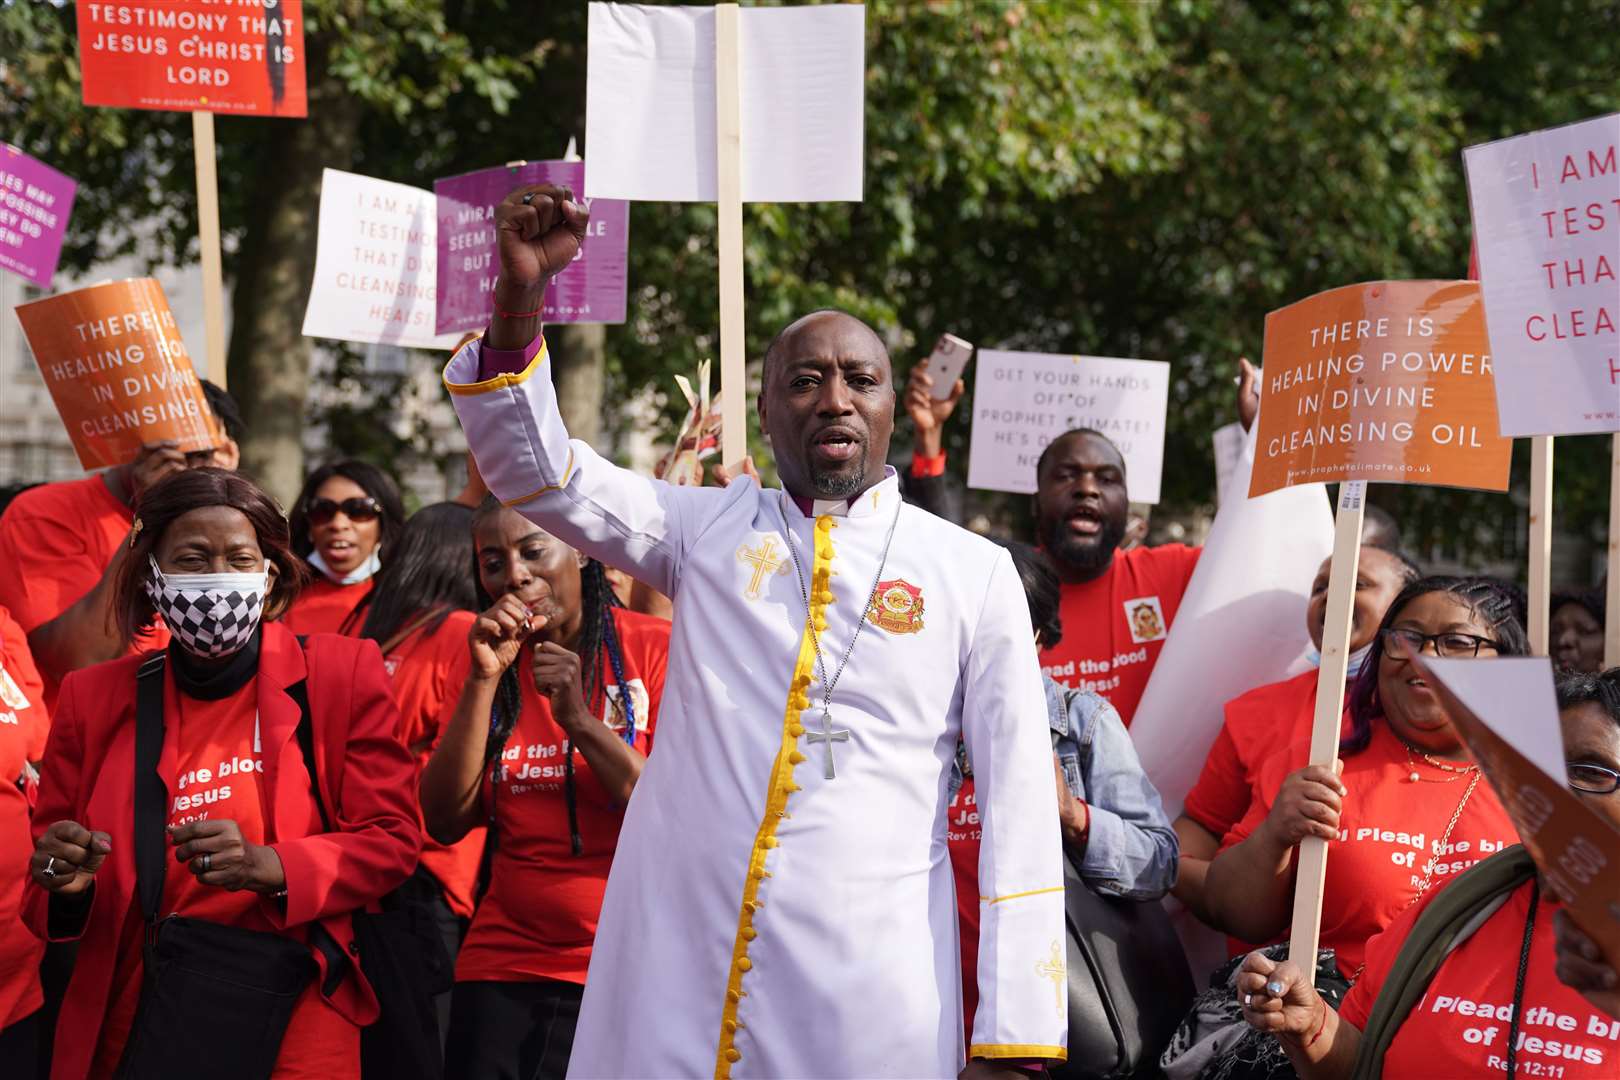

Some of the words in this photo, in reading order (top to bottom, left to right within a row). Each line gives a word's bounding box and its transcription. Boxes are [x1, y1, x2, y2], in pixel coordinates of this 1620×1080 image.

[88, 3, 228, 32] TESTIMONY
[238, 16, 294, 37] THAT
[92, 32, 168, 56] JESUS
[179, 39, 265, 62] CHRIST
[274, 45, 295, 64] IS
[167, 65, 230, 87] LORD
[1532, 162, 1539, 190] I
[1560, 145, 1618, 185] AM
[448, 231, 486, 252] SEEM
[353, 246, 398, 267] THAT
[463, 253, 491, 272] BUT
[1542, 254, 1616, 289] THA
[75, 311, 154, 342] THERE
[1310, 317, 1389, 348] THERE
[1406, 316, 1434, 337] IS
[1525, 306, 1616, 341] CLEA
[51, 344, 145, 381] HEALING
[1271, 353, 1364, 395] HEALING
[1381, 351, 1493, 376] POWER
[993, 368, 1024, 382] GET
[1033, 369, 1081, 387] YOUR
[92, 384, 114, 403] IN
[1297, 393, 1319, 417] IN
[1332, 386, 1435, 409] DIVINE
[980, 408, 1056, 428] PROPHET
[1268, 421, 1414, 458] CLEANSING
[1431, 423, 1482, 448] OIL
[1079, 658, 1110, 674] the
[527, 743, 557, 760] the
[1356, 827, 1425, 850] Plead
[1431, 839, 1471, 856] the
[1391, 851, 1417, 869] of
[1431, 996, 1514, 1023] Plead
[1525, 1006, 1578, 1032] the
[1462, 1026, 1500, 1047] of
[1523, 1060, 1565, 1079] 12:11
